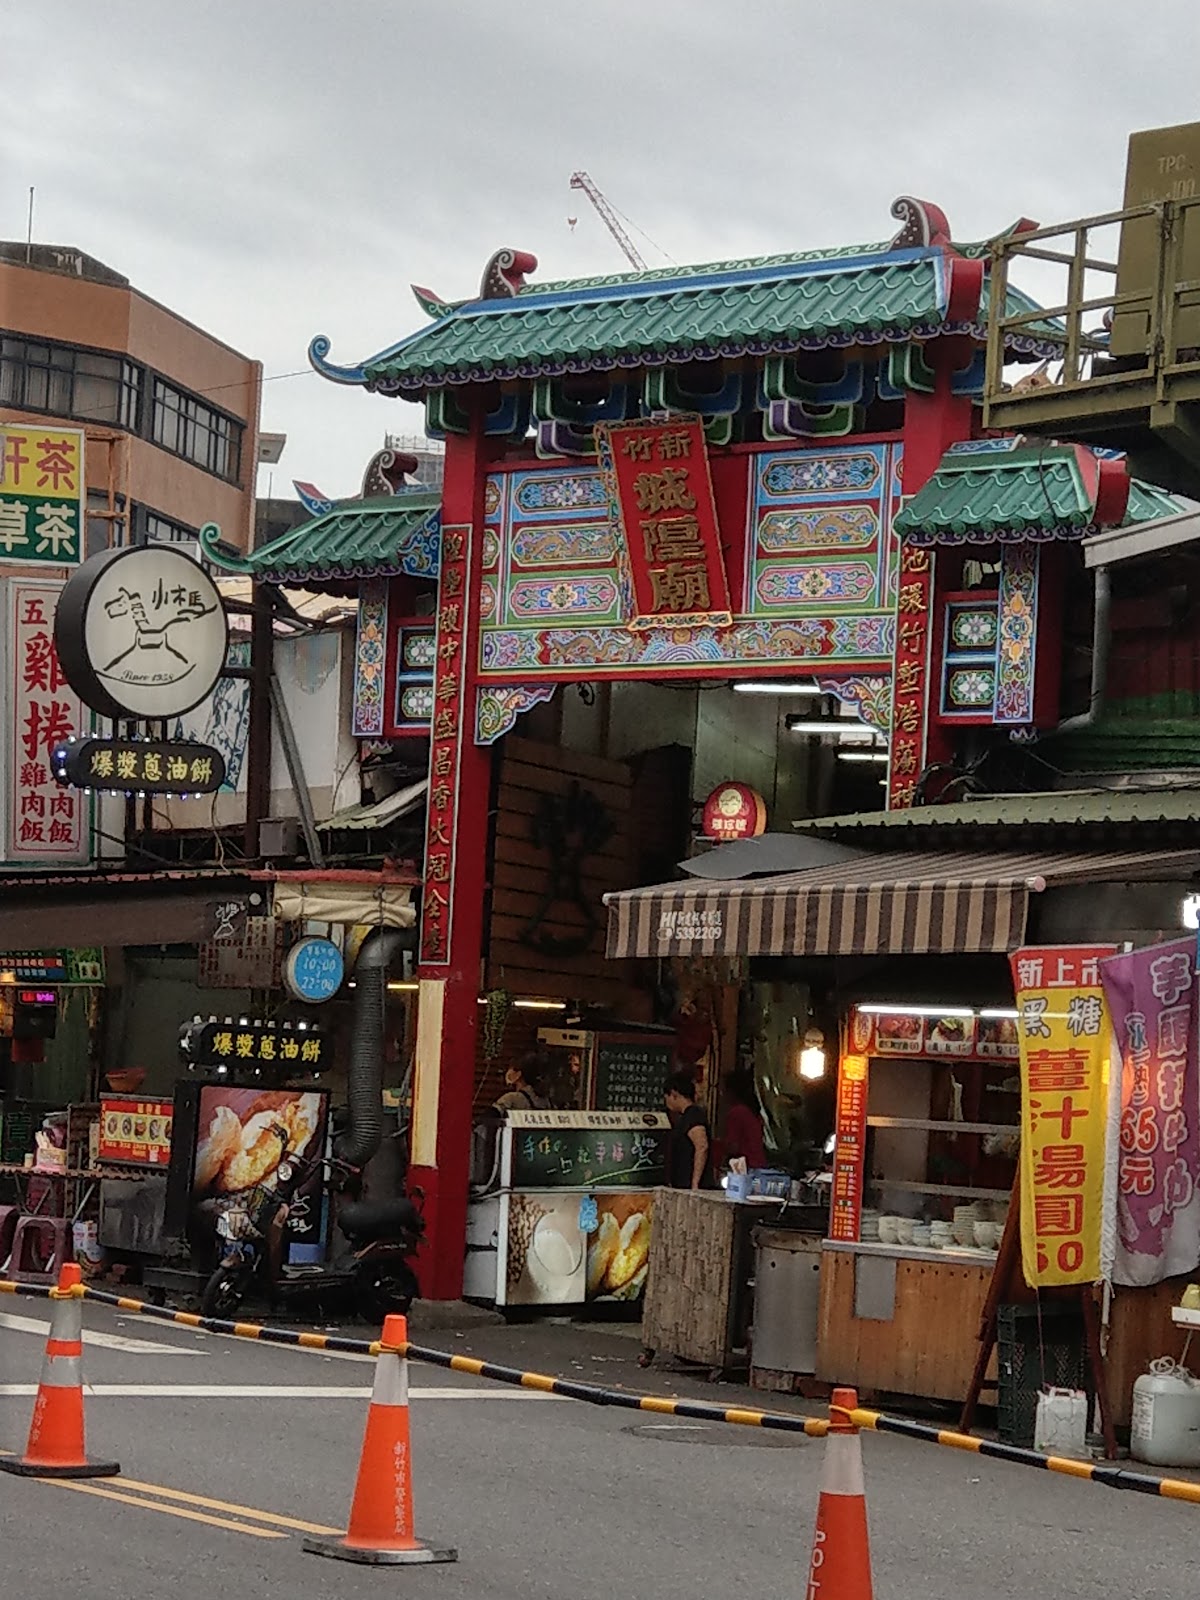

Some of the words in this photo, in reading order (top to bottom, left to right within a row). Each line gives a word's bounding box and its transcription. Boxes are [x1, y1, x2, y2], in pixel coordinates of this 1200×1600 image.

[1158, 154, 1186, 174] TPC
[622, 431, 692, 462] 新竹
[633, 467, 711, 613] 城隍廟
[19, 762, 47, 843] 雞肉飯
[48, 776, 75, 844] 肉飯
[1022, 996, 1103, 1038] 黑糖
